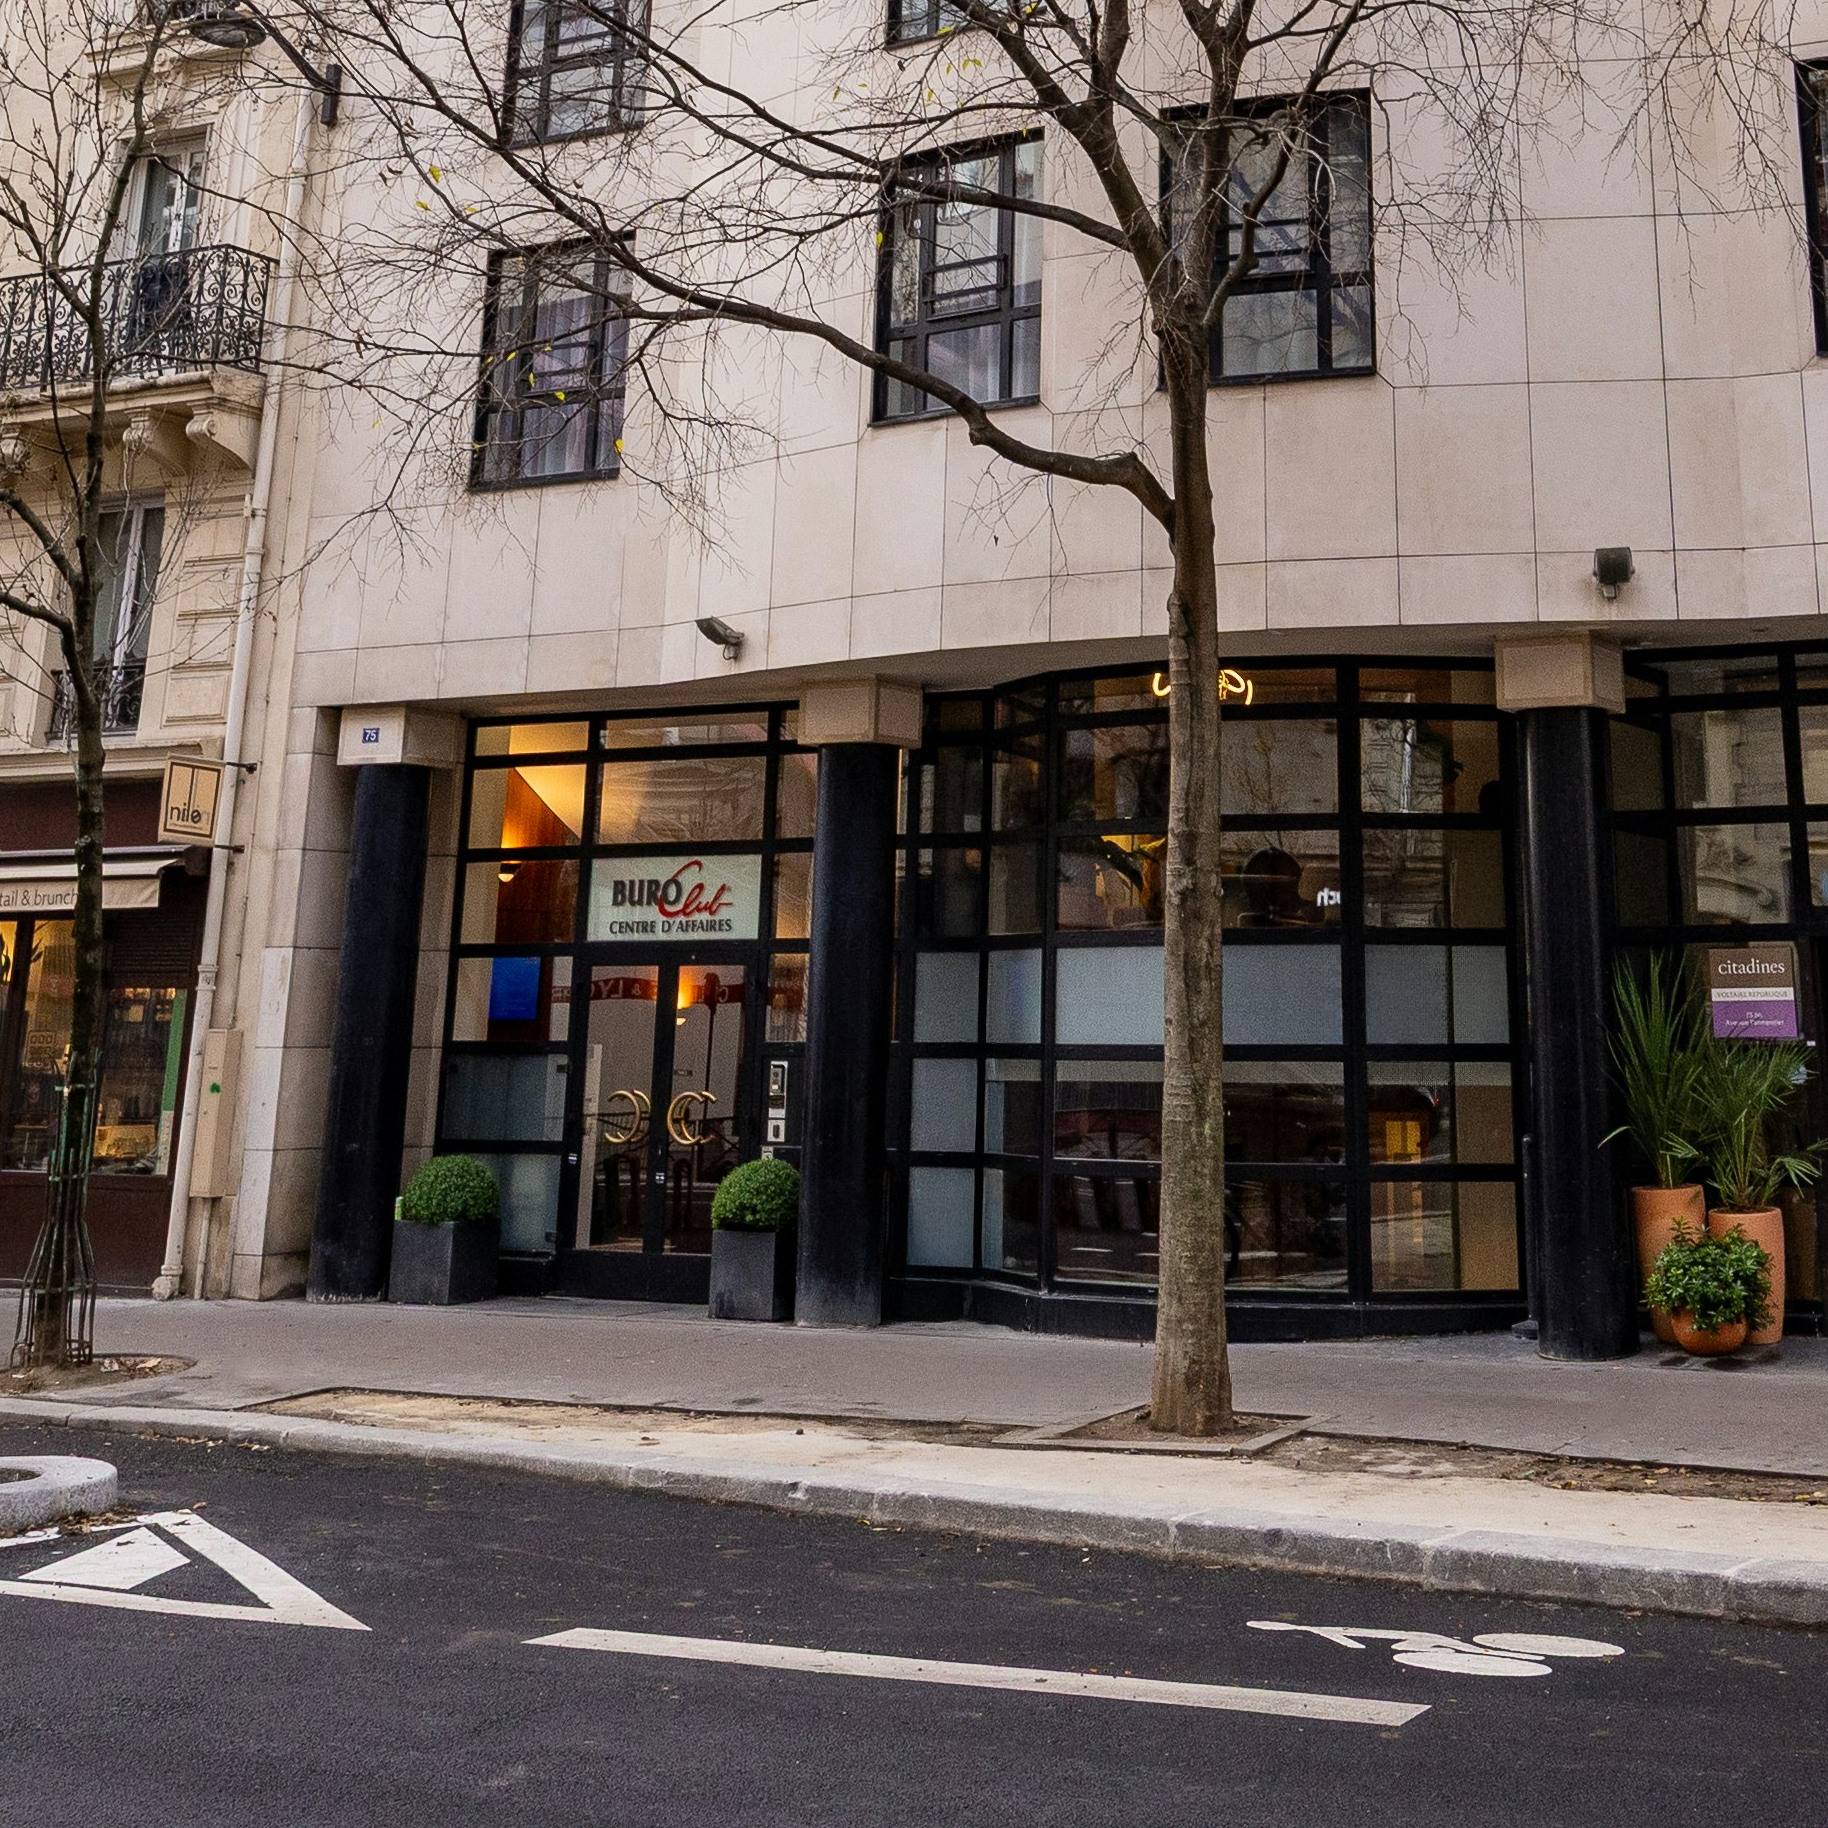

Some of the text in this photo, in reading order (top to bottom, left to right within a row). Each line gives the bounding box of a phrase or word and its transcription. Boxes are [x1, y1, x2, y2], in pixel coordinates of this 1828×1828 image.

[365, 729, 377, 741] 75
[21, 889, 31, 906] &
[33, 887, 79, 906] brunch
[612, 860, 733, 918] BURO Club
[609, 918, 733, 935] CENTRE D'AFFAIRES
[1718, 957, 1786, 975] citadines
